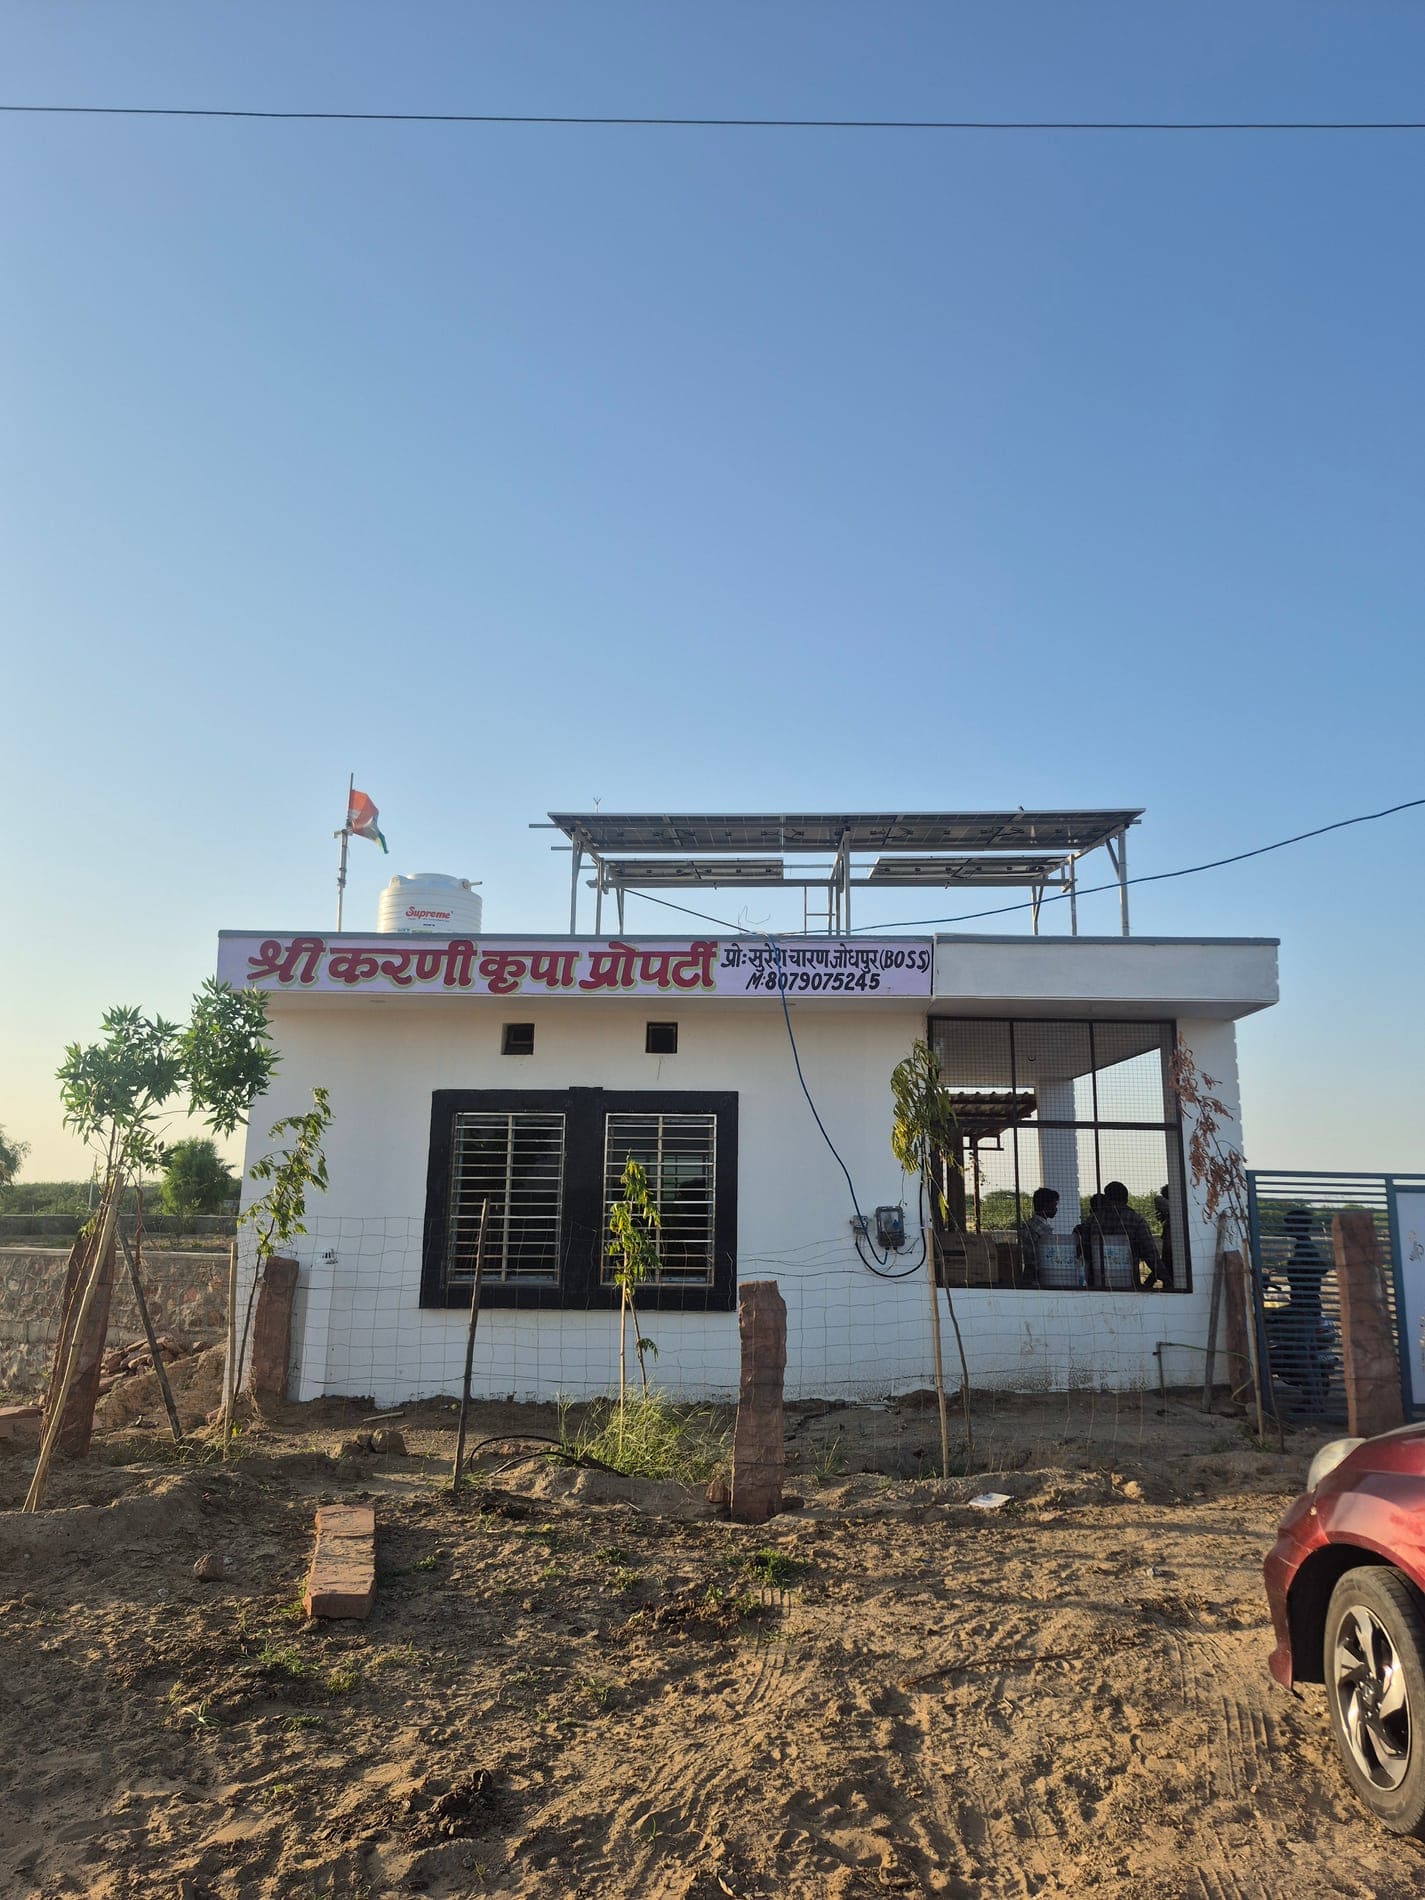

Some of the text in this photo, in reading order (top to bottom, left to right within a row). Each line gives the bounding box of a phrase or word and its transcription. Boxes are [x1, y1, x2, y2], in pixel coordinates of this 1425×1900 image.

[406, 906, 451, 919] Supreme
[246, 937, 718, 994] श्री करणी कृपा प्रोपर्टी
